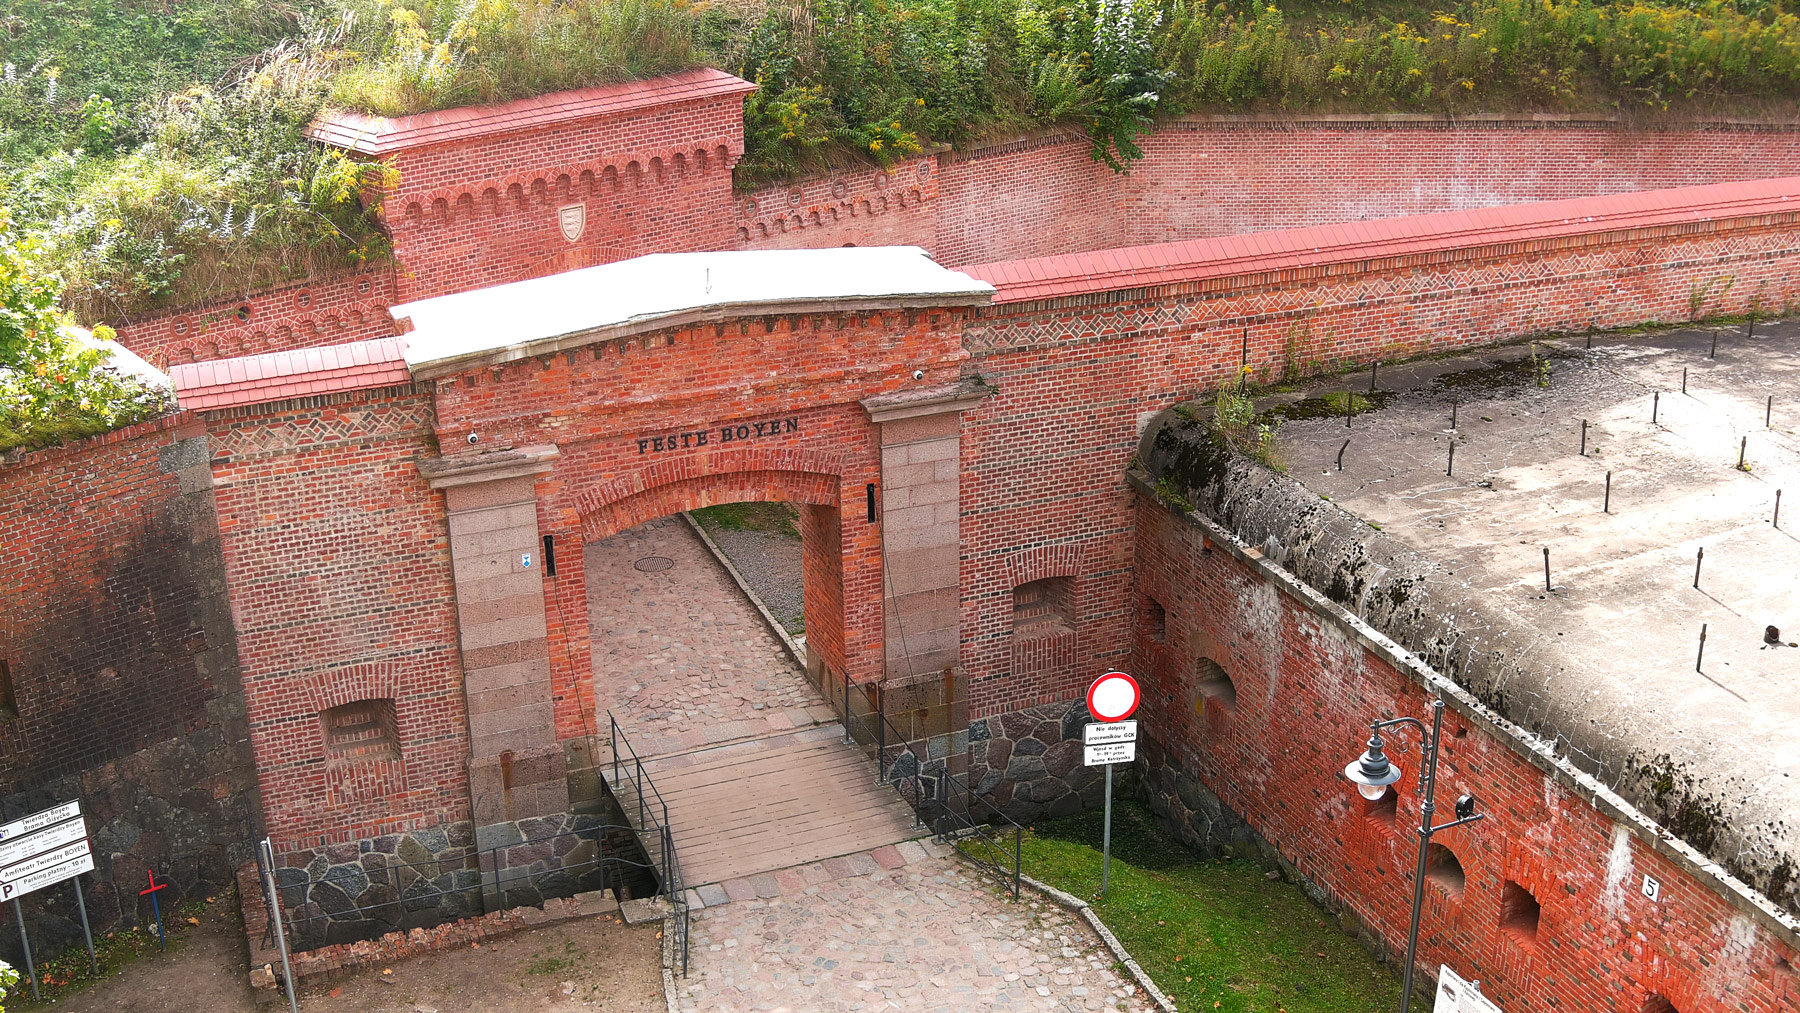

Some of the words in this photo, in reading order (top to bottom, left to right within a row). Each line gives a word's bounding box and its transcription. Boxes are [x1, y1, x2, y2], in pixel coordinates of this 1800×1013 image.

[637, 430, 708, 454] FESTE
[721, 416, 799, 443] BOYEN
[22, 813, 49, 825] Twierdza
[50, 806, 70, 816] Boyen
[23, 821, 44, 831] Brama
[4, 863, 35, 878] Amfiteatr
[36, 854, 63, 867] Twierdzy
[64, 844, 86, 857] BOYEN
[23, 873, 47, 885] Parking
[1645, 878, 1656, 897] 5
[2, 884, 13, 899] P
